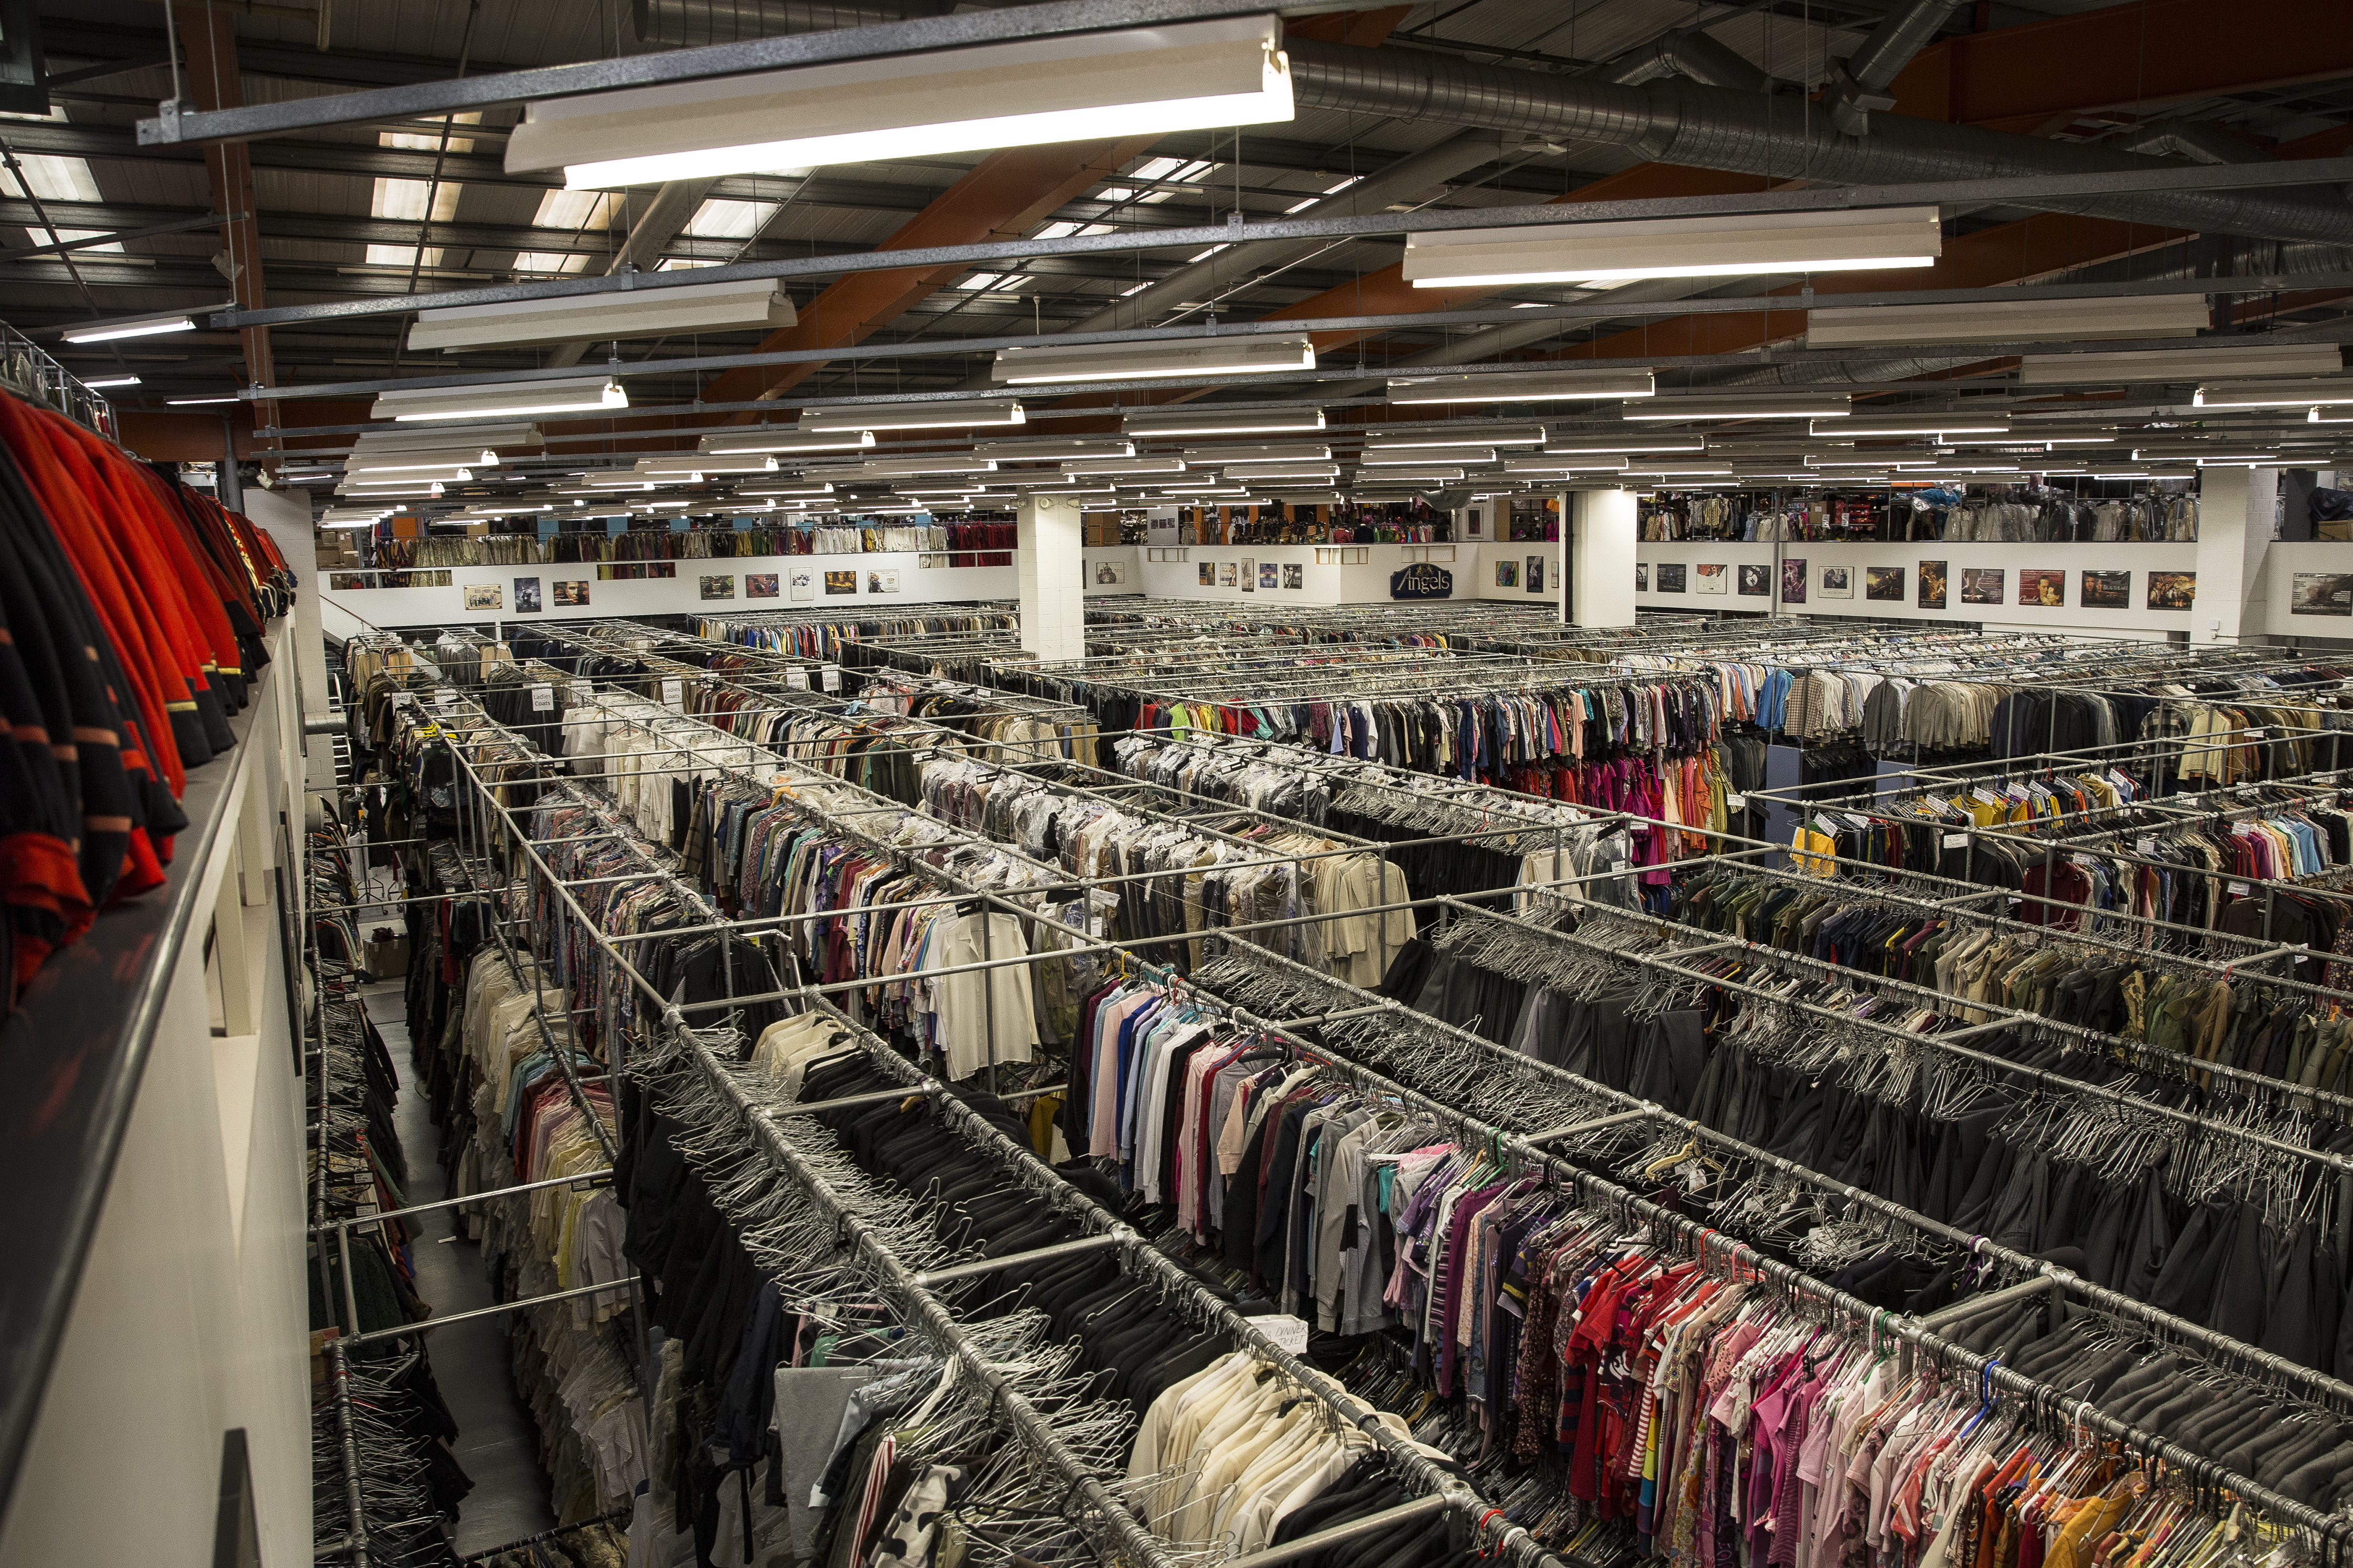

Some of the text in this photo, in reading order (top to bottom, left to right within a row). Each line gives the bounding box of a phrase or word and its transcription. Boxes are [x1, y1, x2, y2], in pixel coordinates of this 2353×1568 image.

[1396, 568, 1449, 594] Angels
[1275, 1323, 1308, 1337] DINNER
[1280, 1335, 1306, 1347] JACKET
